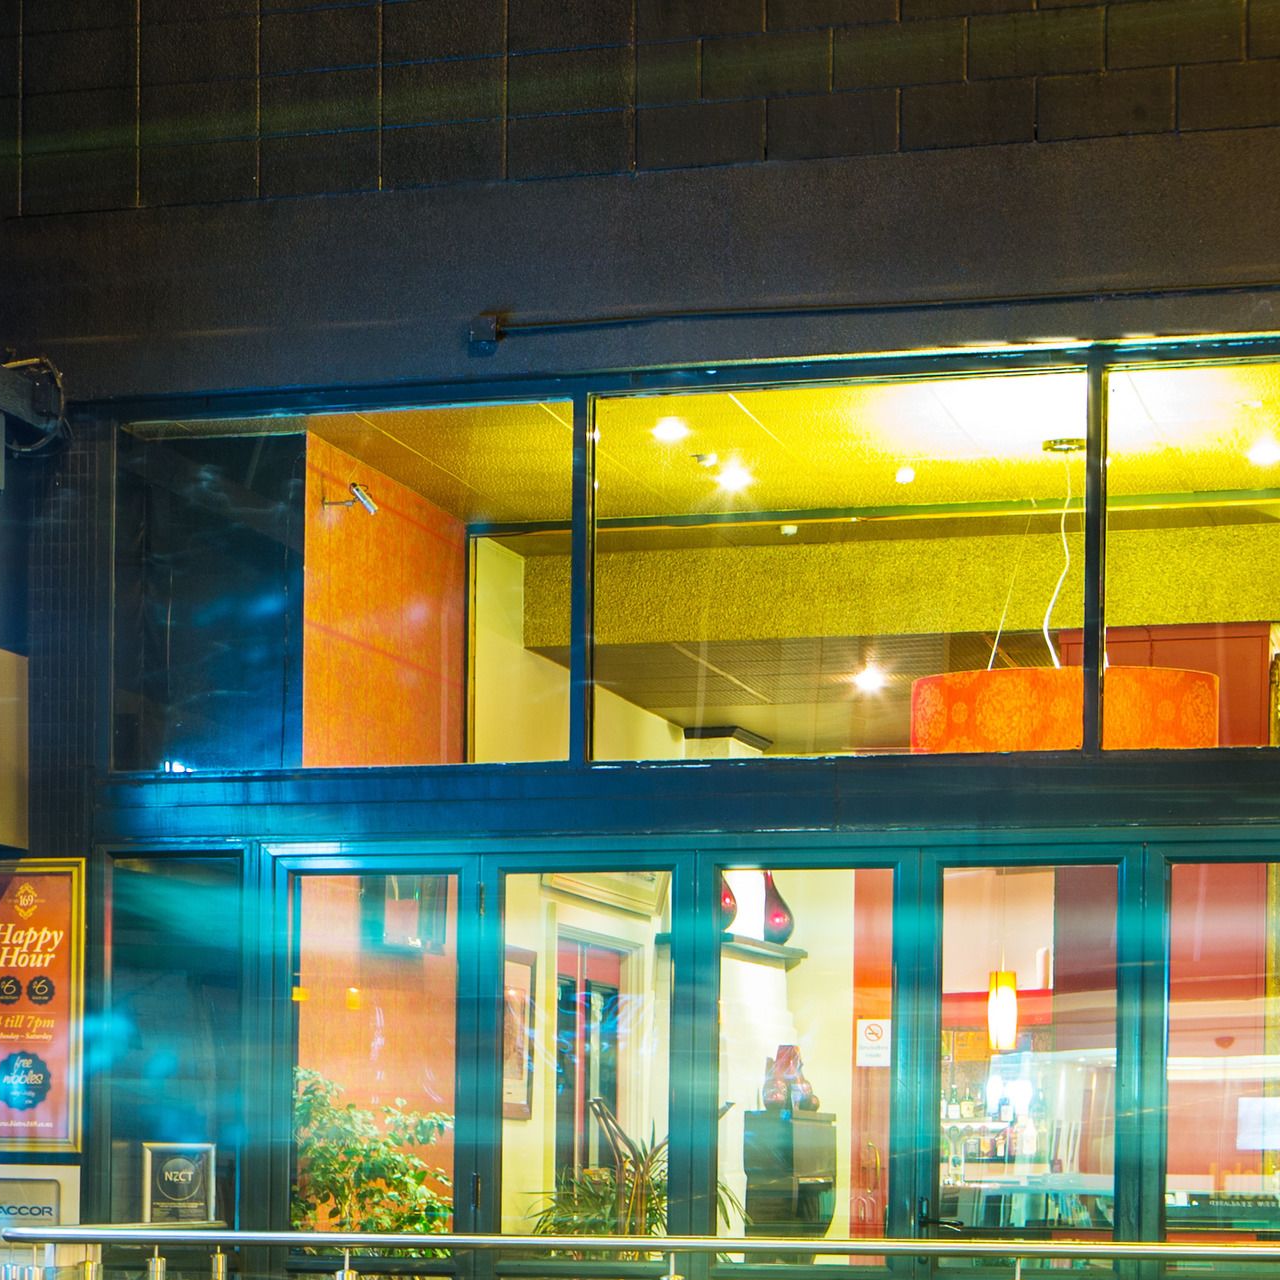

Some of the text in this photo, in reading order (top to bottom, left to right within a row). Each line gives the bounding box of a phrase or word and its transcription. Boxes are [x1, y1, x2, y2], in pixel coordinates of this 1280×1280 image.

[4, 1015, 24, 1028] till
[26, 1015, 55, 1033] 7pm
[13, 1055, 33, 1075] free
[164, 1170, 194, 1183] NZCT
